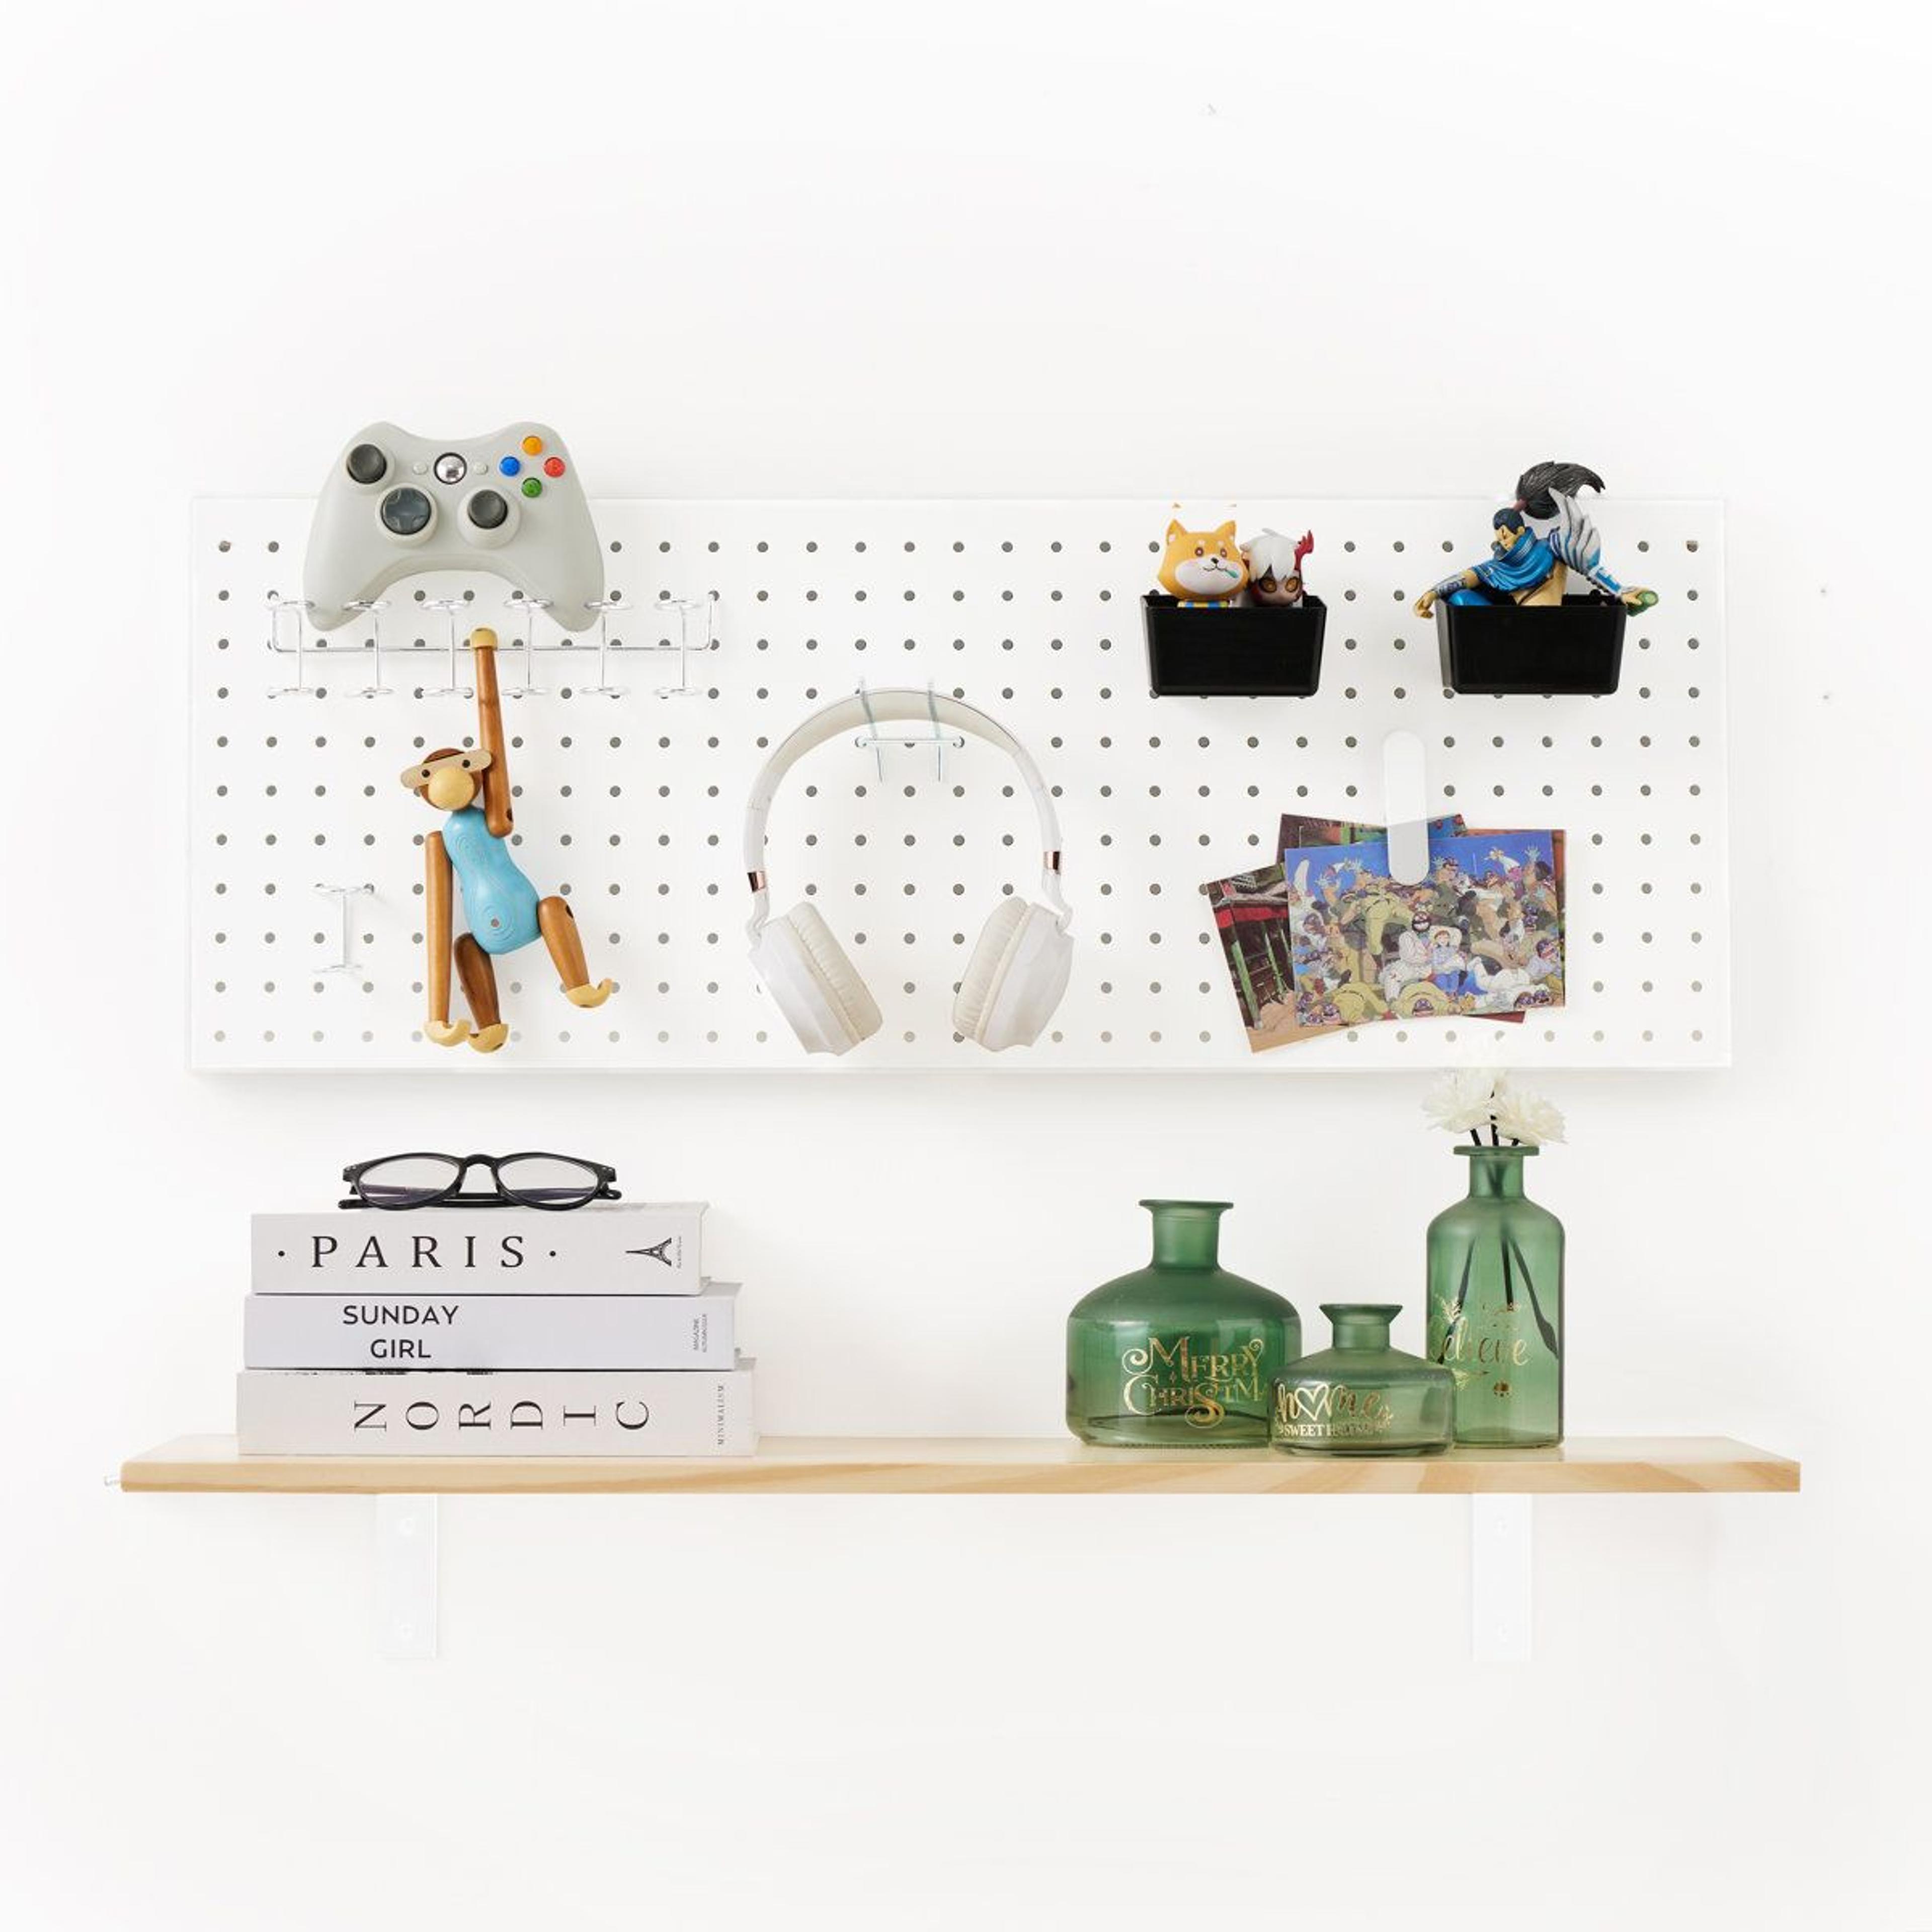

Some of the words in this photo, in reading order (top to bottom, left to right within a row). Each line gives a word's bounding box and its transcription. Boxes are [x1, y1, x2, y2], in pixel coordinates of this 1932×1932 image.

[311, 1235, 524, 1268] PARIS
[342, 1305, 459, 1325] SUNDAY
[370, 1338, 432, 1359] GIRL
[353, 1400, 650, 1431] NORDIC
[1284, 1423, 1325, 1437] SWEET
